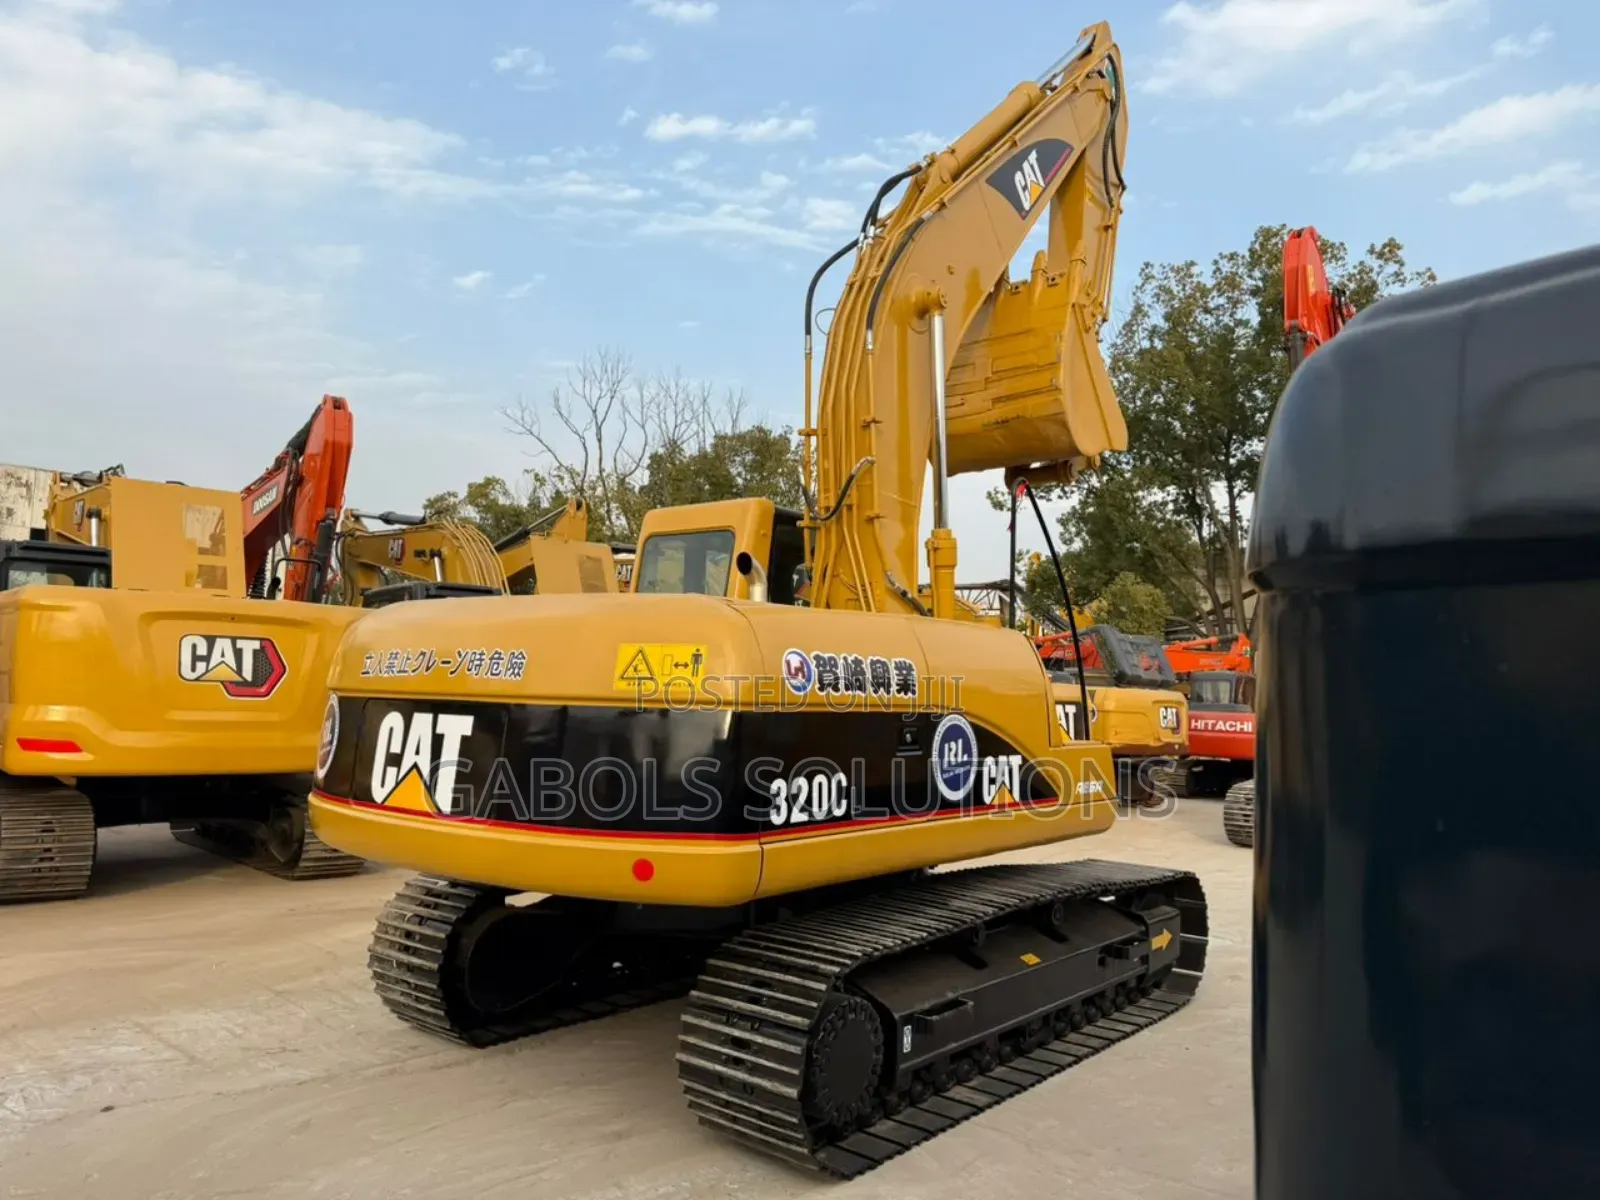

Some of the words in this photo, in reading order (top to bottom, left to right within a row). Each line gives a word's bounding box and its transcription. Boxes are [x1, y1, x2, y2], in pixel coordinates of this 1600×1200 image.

[1014, 148, 1046, 211] CAT
[180, 635, 261, 682] CAT
[1056, 704, 1077, 741] AT
[1159, 706, 1178, 729] CAT
[1190, 719, 1253, 733] HITACHI
[371, 711, 474, 815] CAT
[982, 755, 1022, 805] CAT
